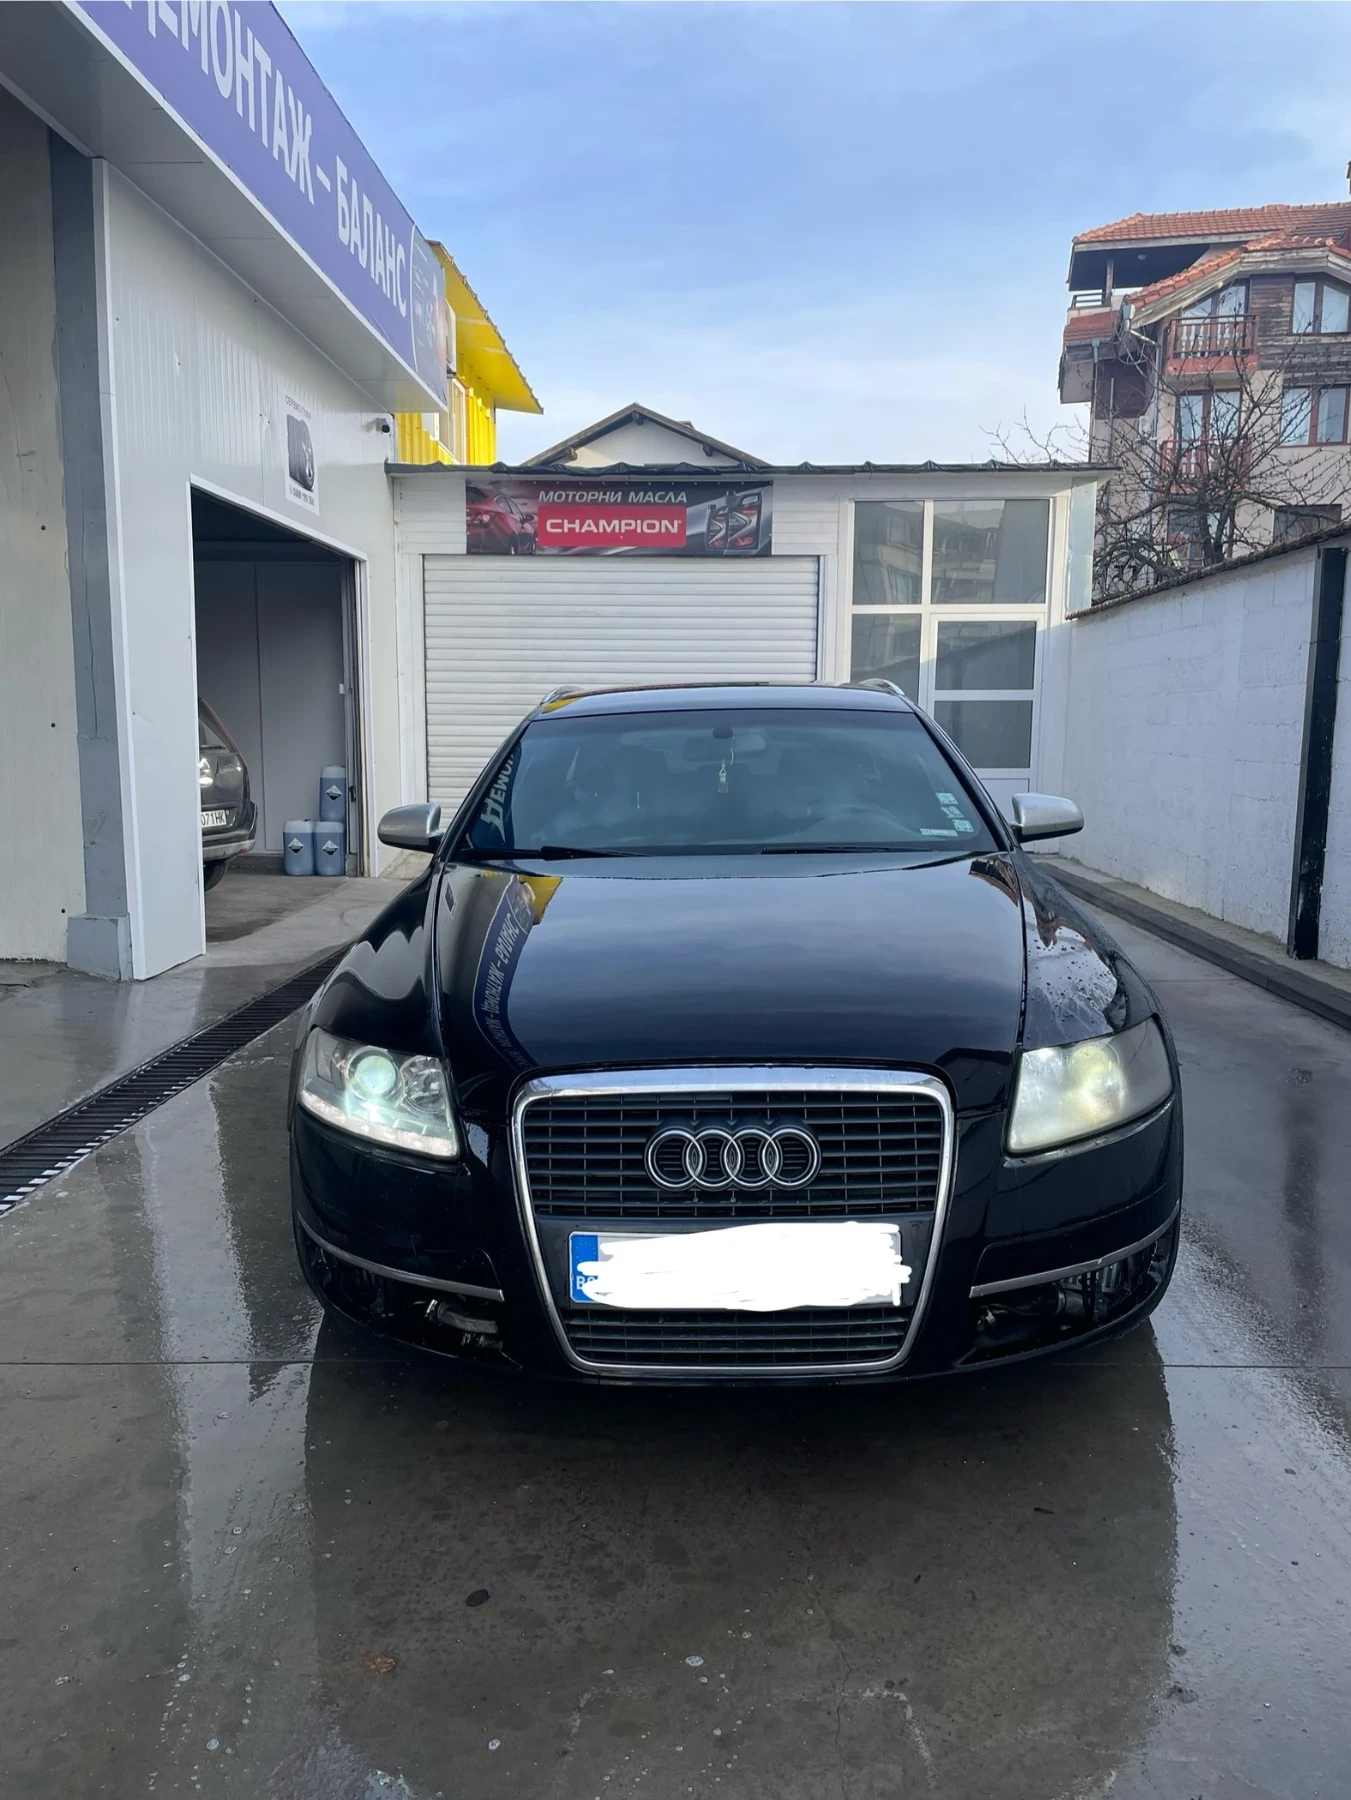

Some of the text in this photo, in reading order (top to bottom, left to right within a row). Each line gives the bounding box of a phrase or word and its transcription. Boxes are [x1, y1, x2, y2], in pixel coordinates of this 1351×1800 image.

[336, 155, 407, 318] БАЛАНС
[538, 490, 687, 504] МОТОРНИ МАСЛА
[546, 519, 679, 533] CHAMPION
